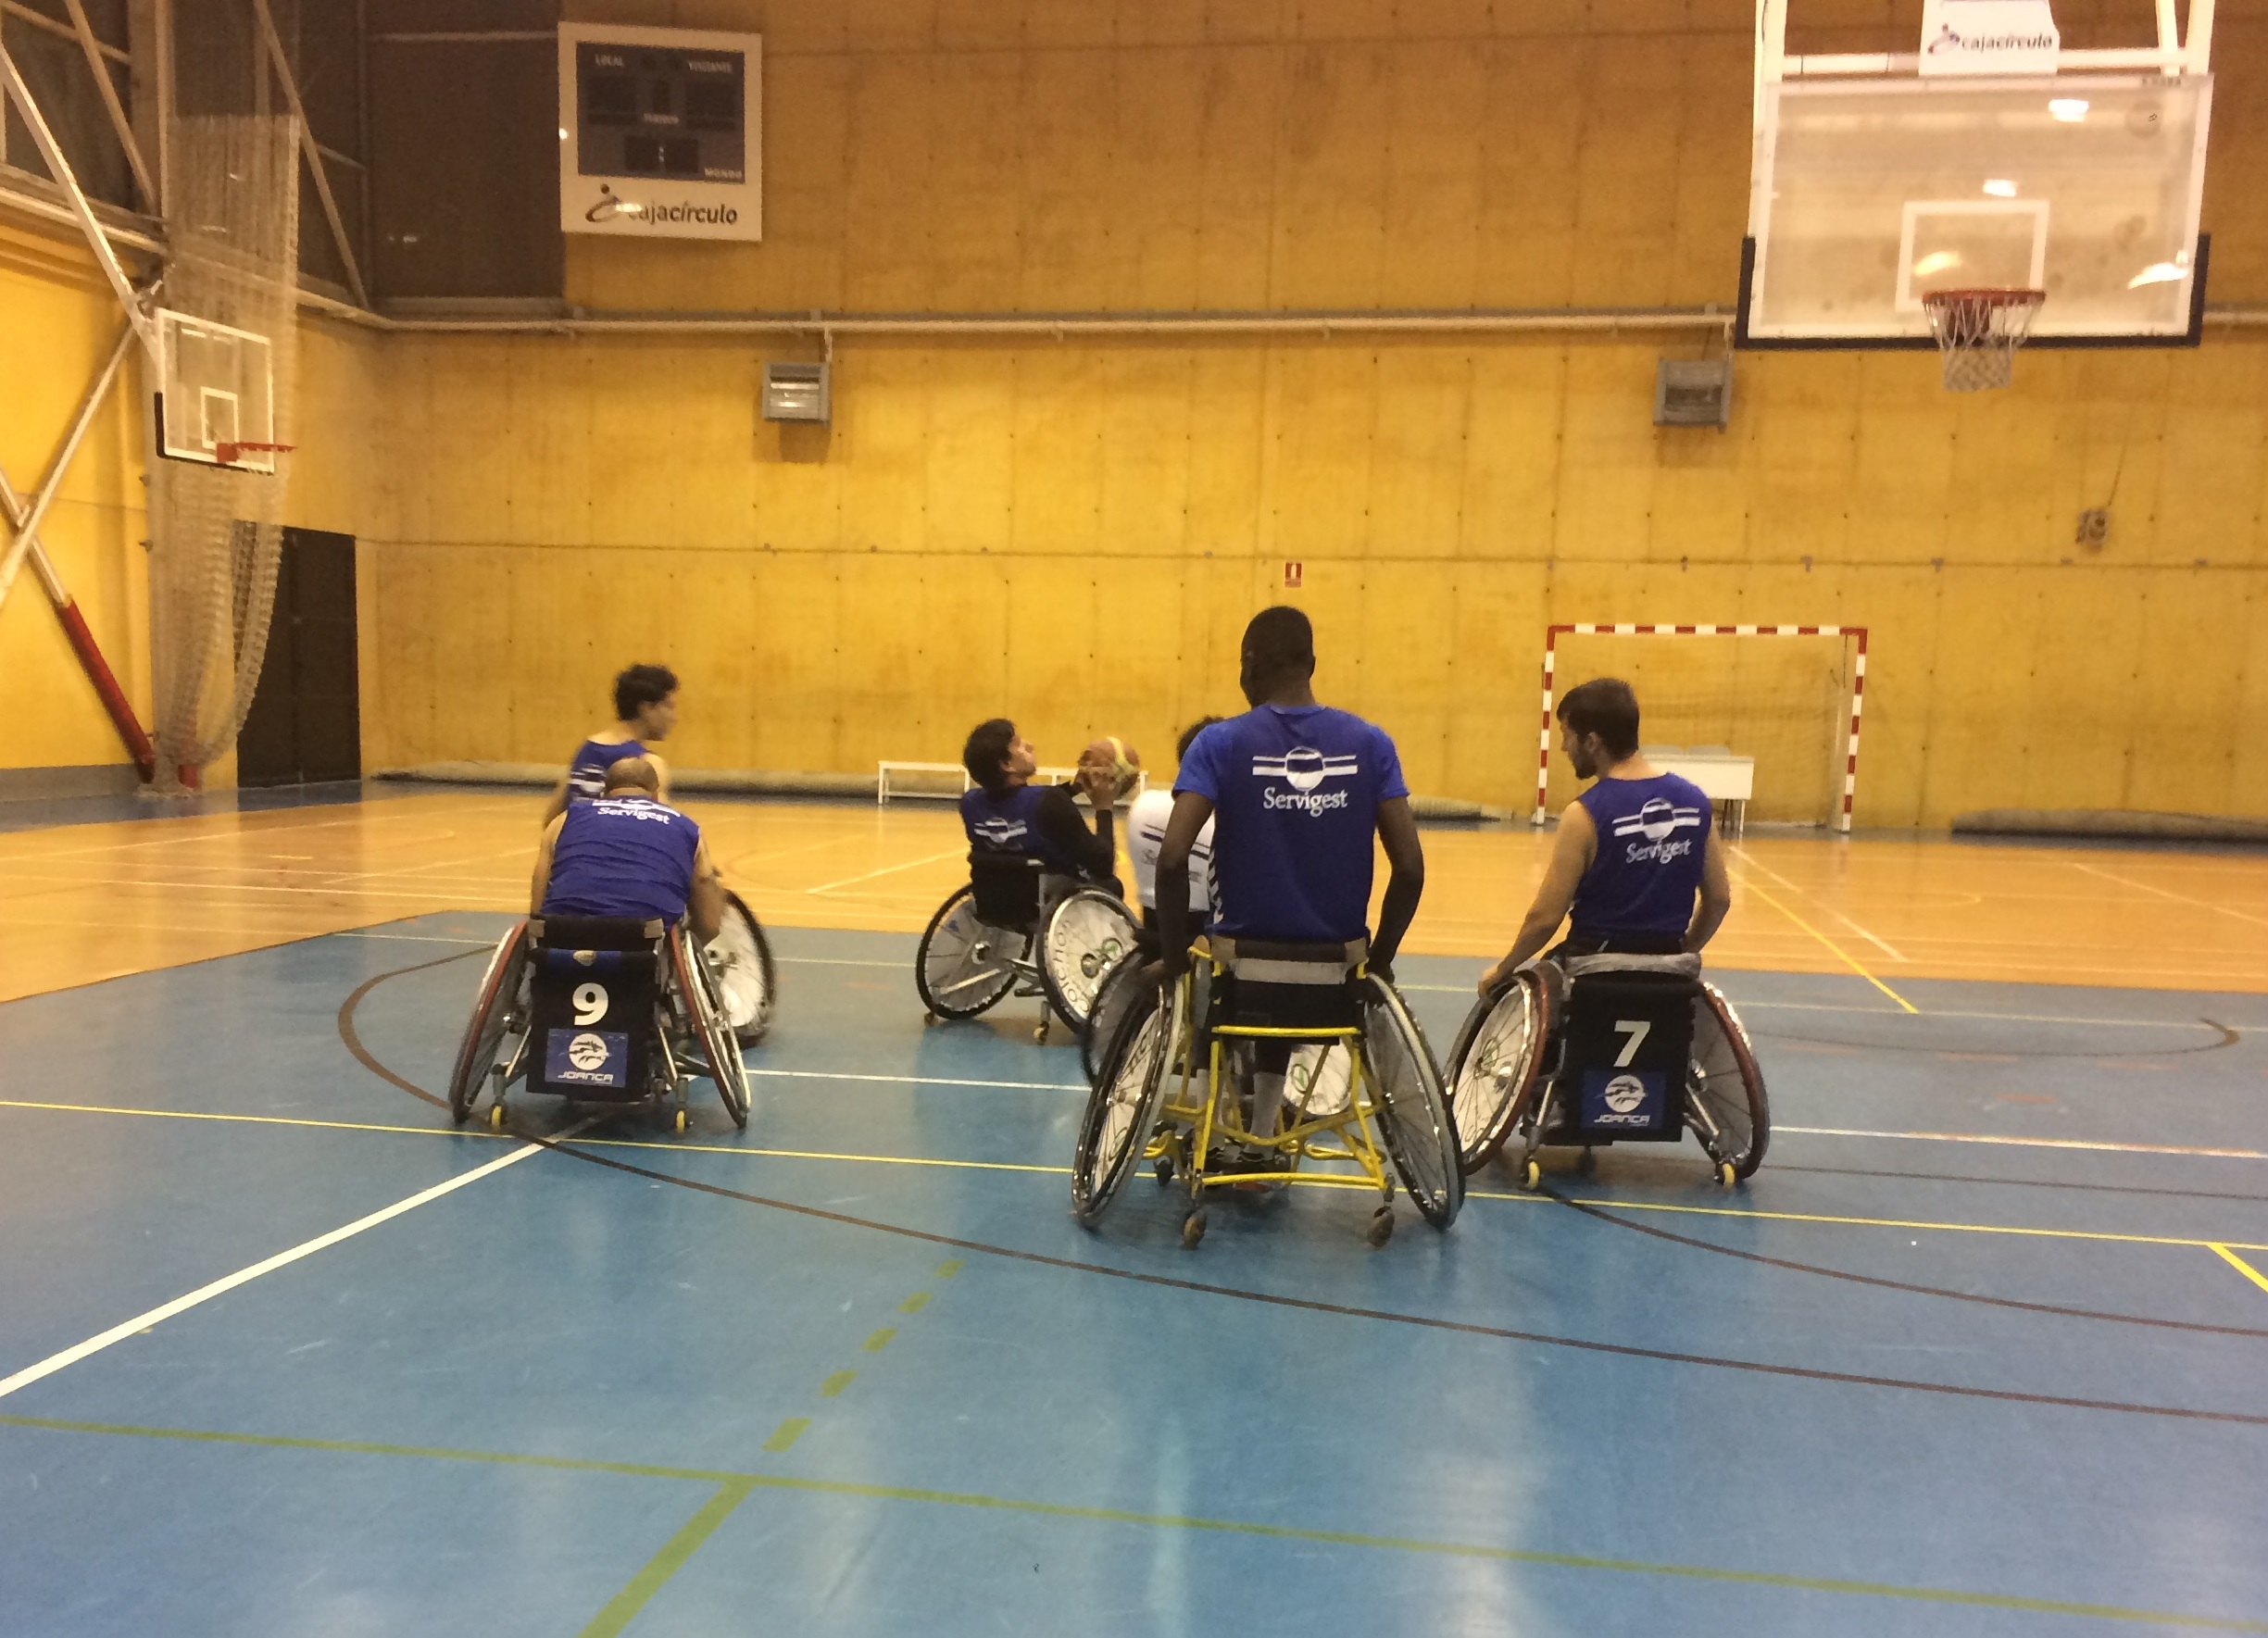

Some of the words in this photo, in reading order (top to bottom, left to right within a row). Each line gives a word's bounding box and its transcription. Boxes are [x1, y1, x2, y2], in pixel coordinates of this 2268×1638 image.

[596, 806, 671, 825] Servigest
[1262, 785, 1348, 818] Servigest
[1625, 838, 1693, 865] Servigest
[571, 982, 609, 1026] 9
[1612, 1019, 1651, 1068] 7
